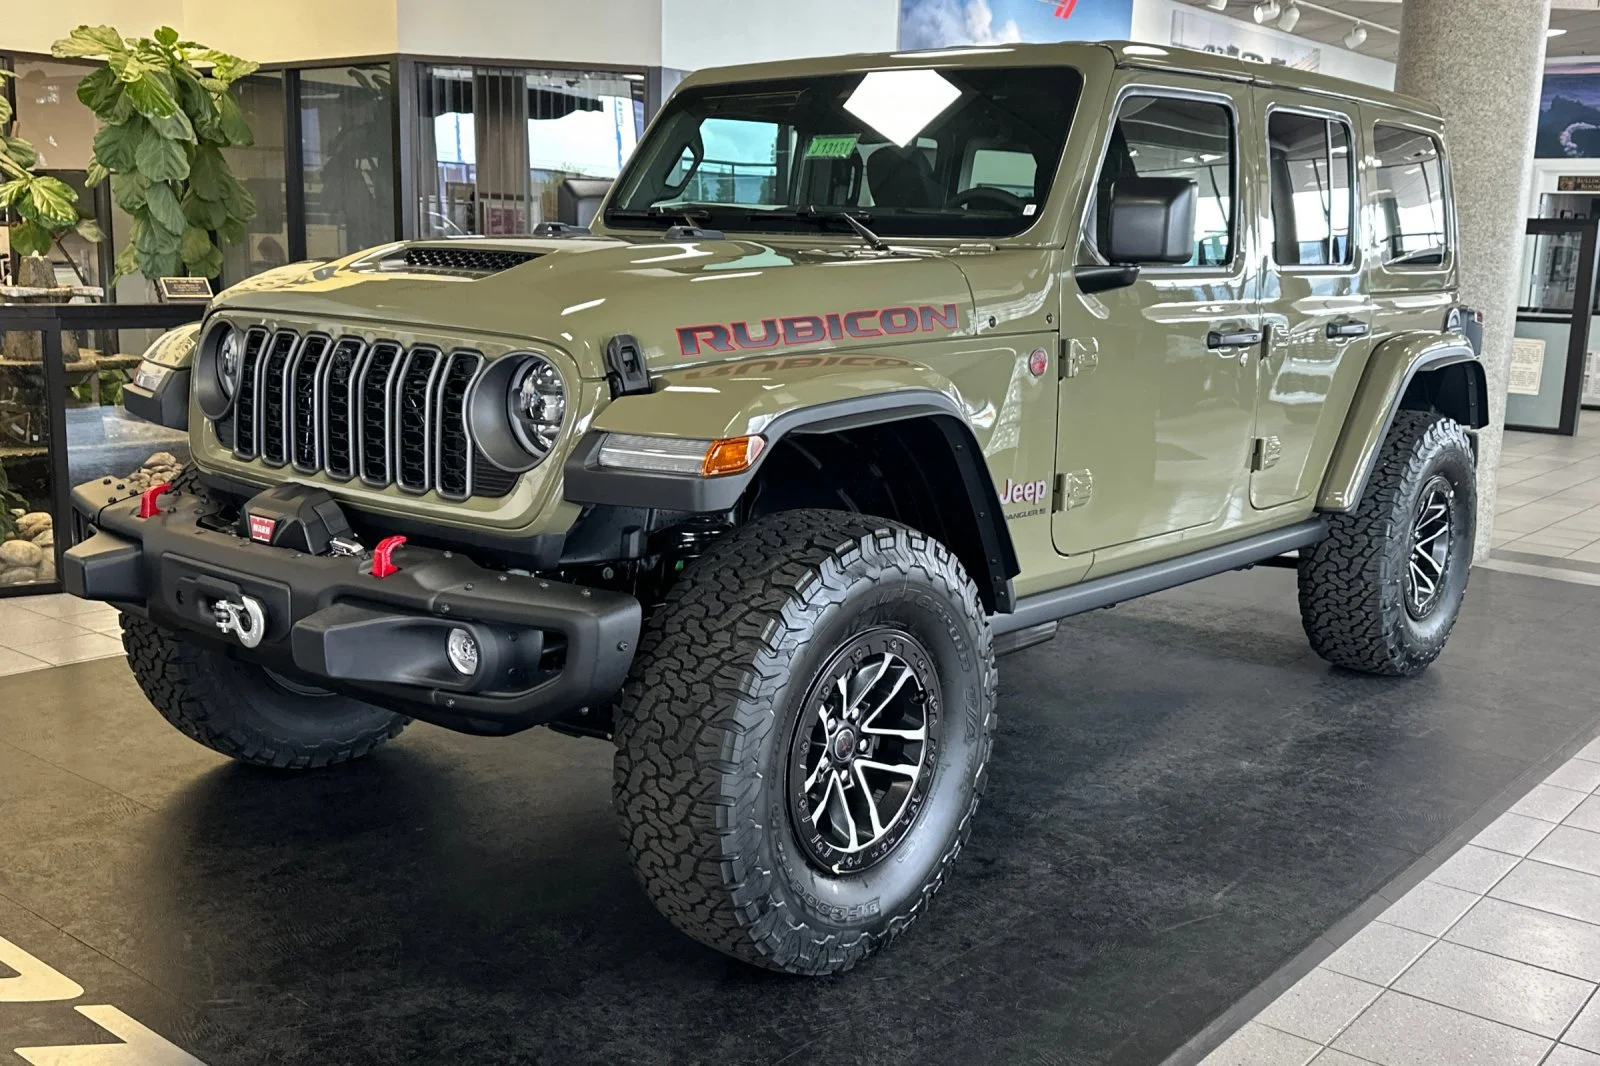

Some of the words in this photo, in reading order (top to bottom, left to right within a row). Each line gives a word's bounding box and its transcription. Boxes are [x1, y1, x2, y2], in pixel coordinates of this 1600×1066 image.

[676, 303, 959, 355] RUBICON
[999, 478, 1047, 505] Jeep
[1005, 508, 1038, 520] ANGLER
